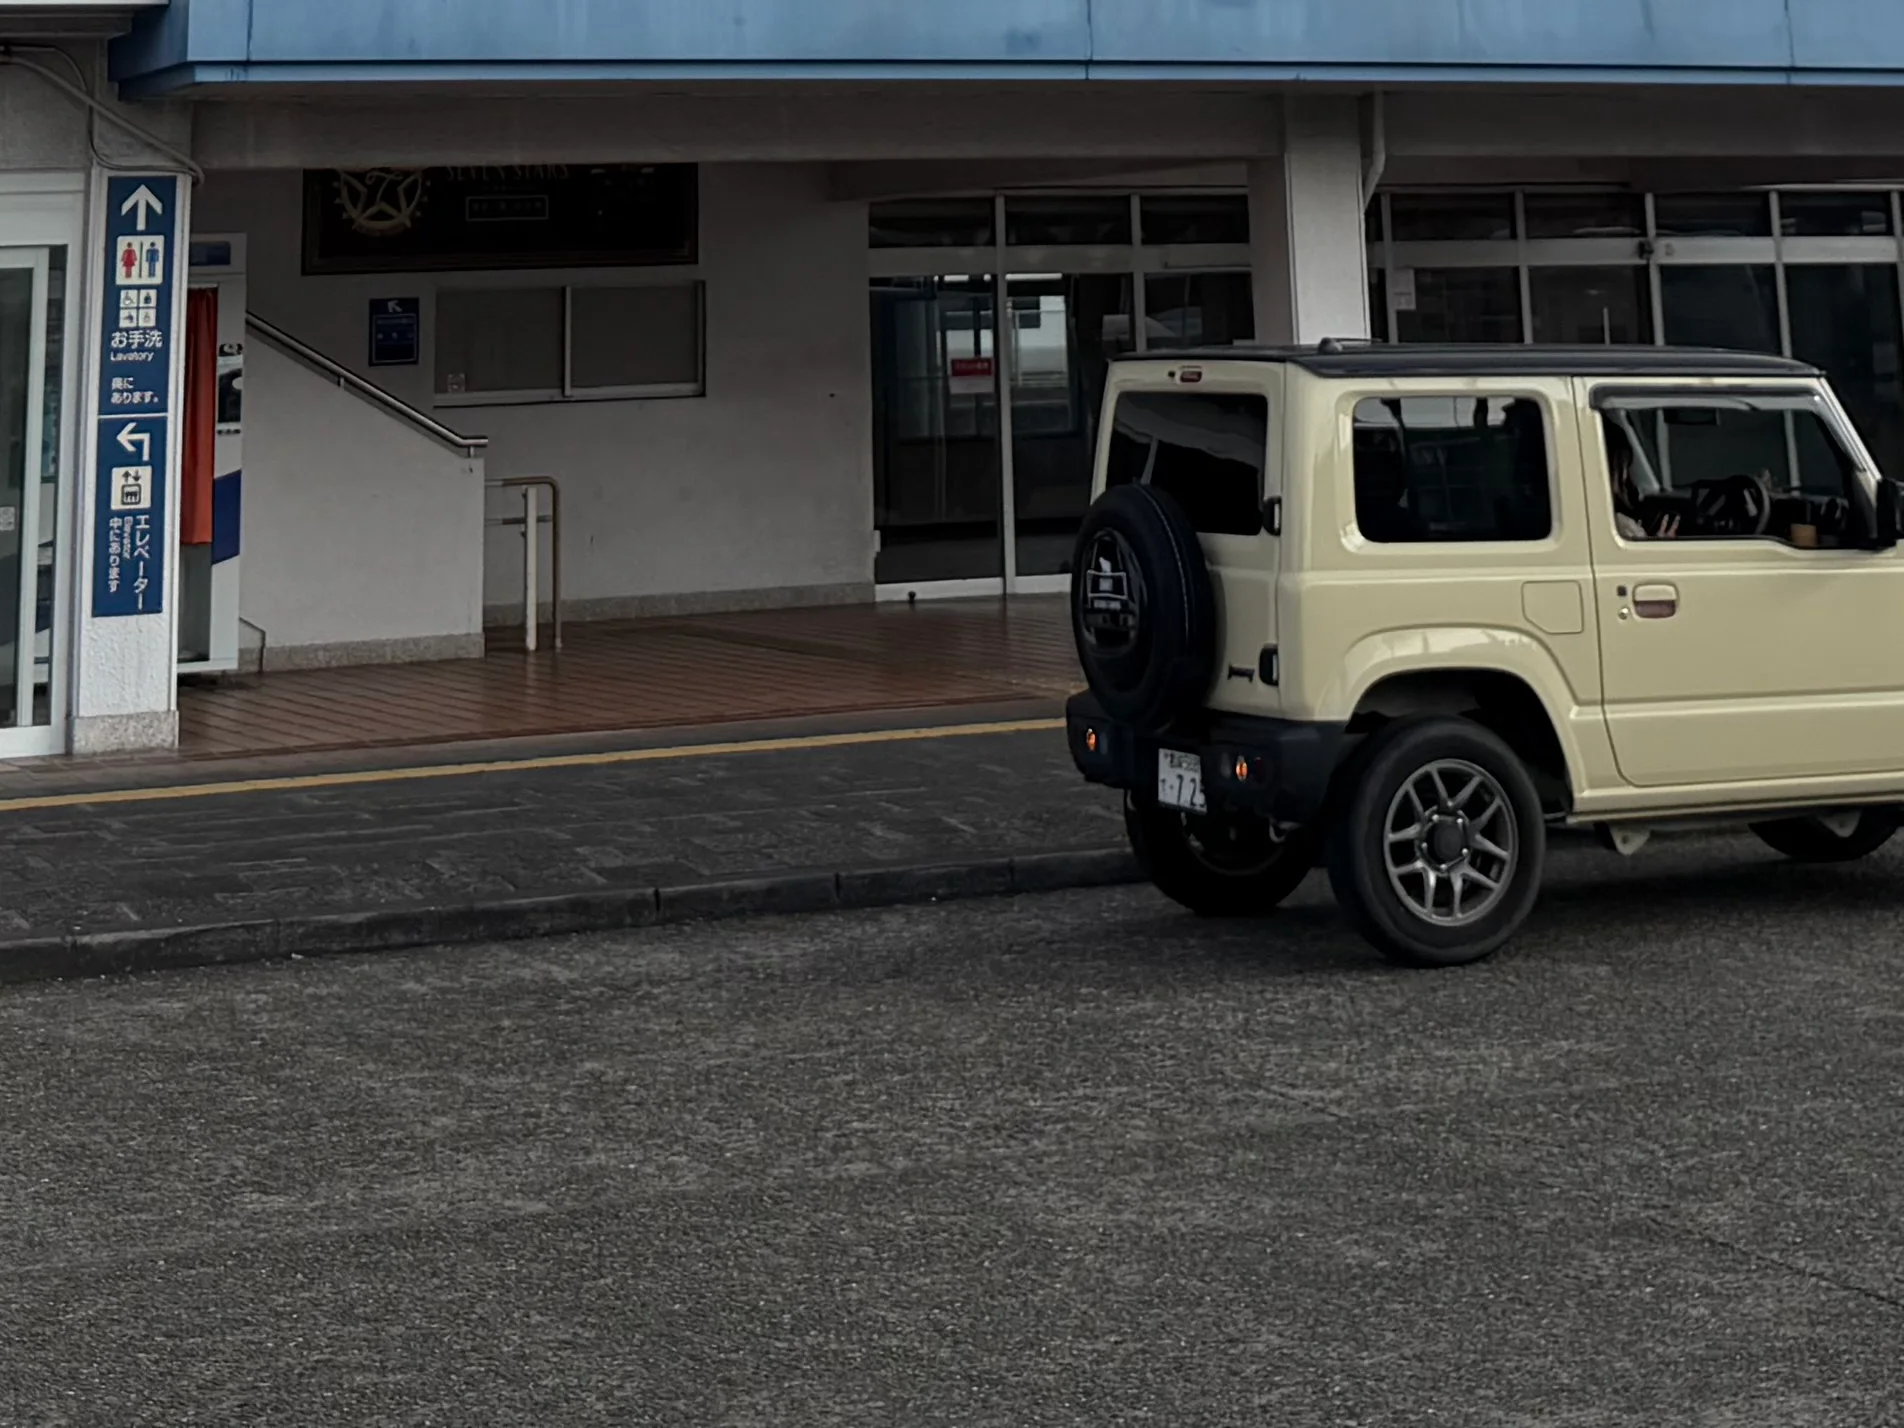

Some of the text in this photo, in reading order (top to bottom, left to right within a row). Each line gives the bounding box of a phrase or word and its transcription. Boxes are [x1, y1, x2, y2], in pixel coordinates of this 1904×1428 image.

[134, 515, 151, 610] エレベーター
